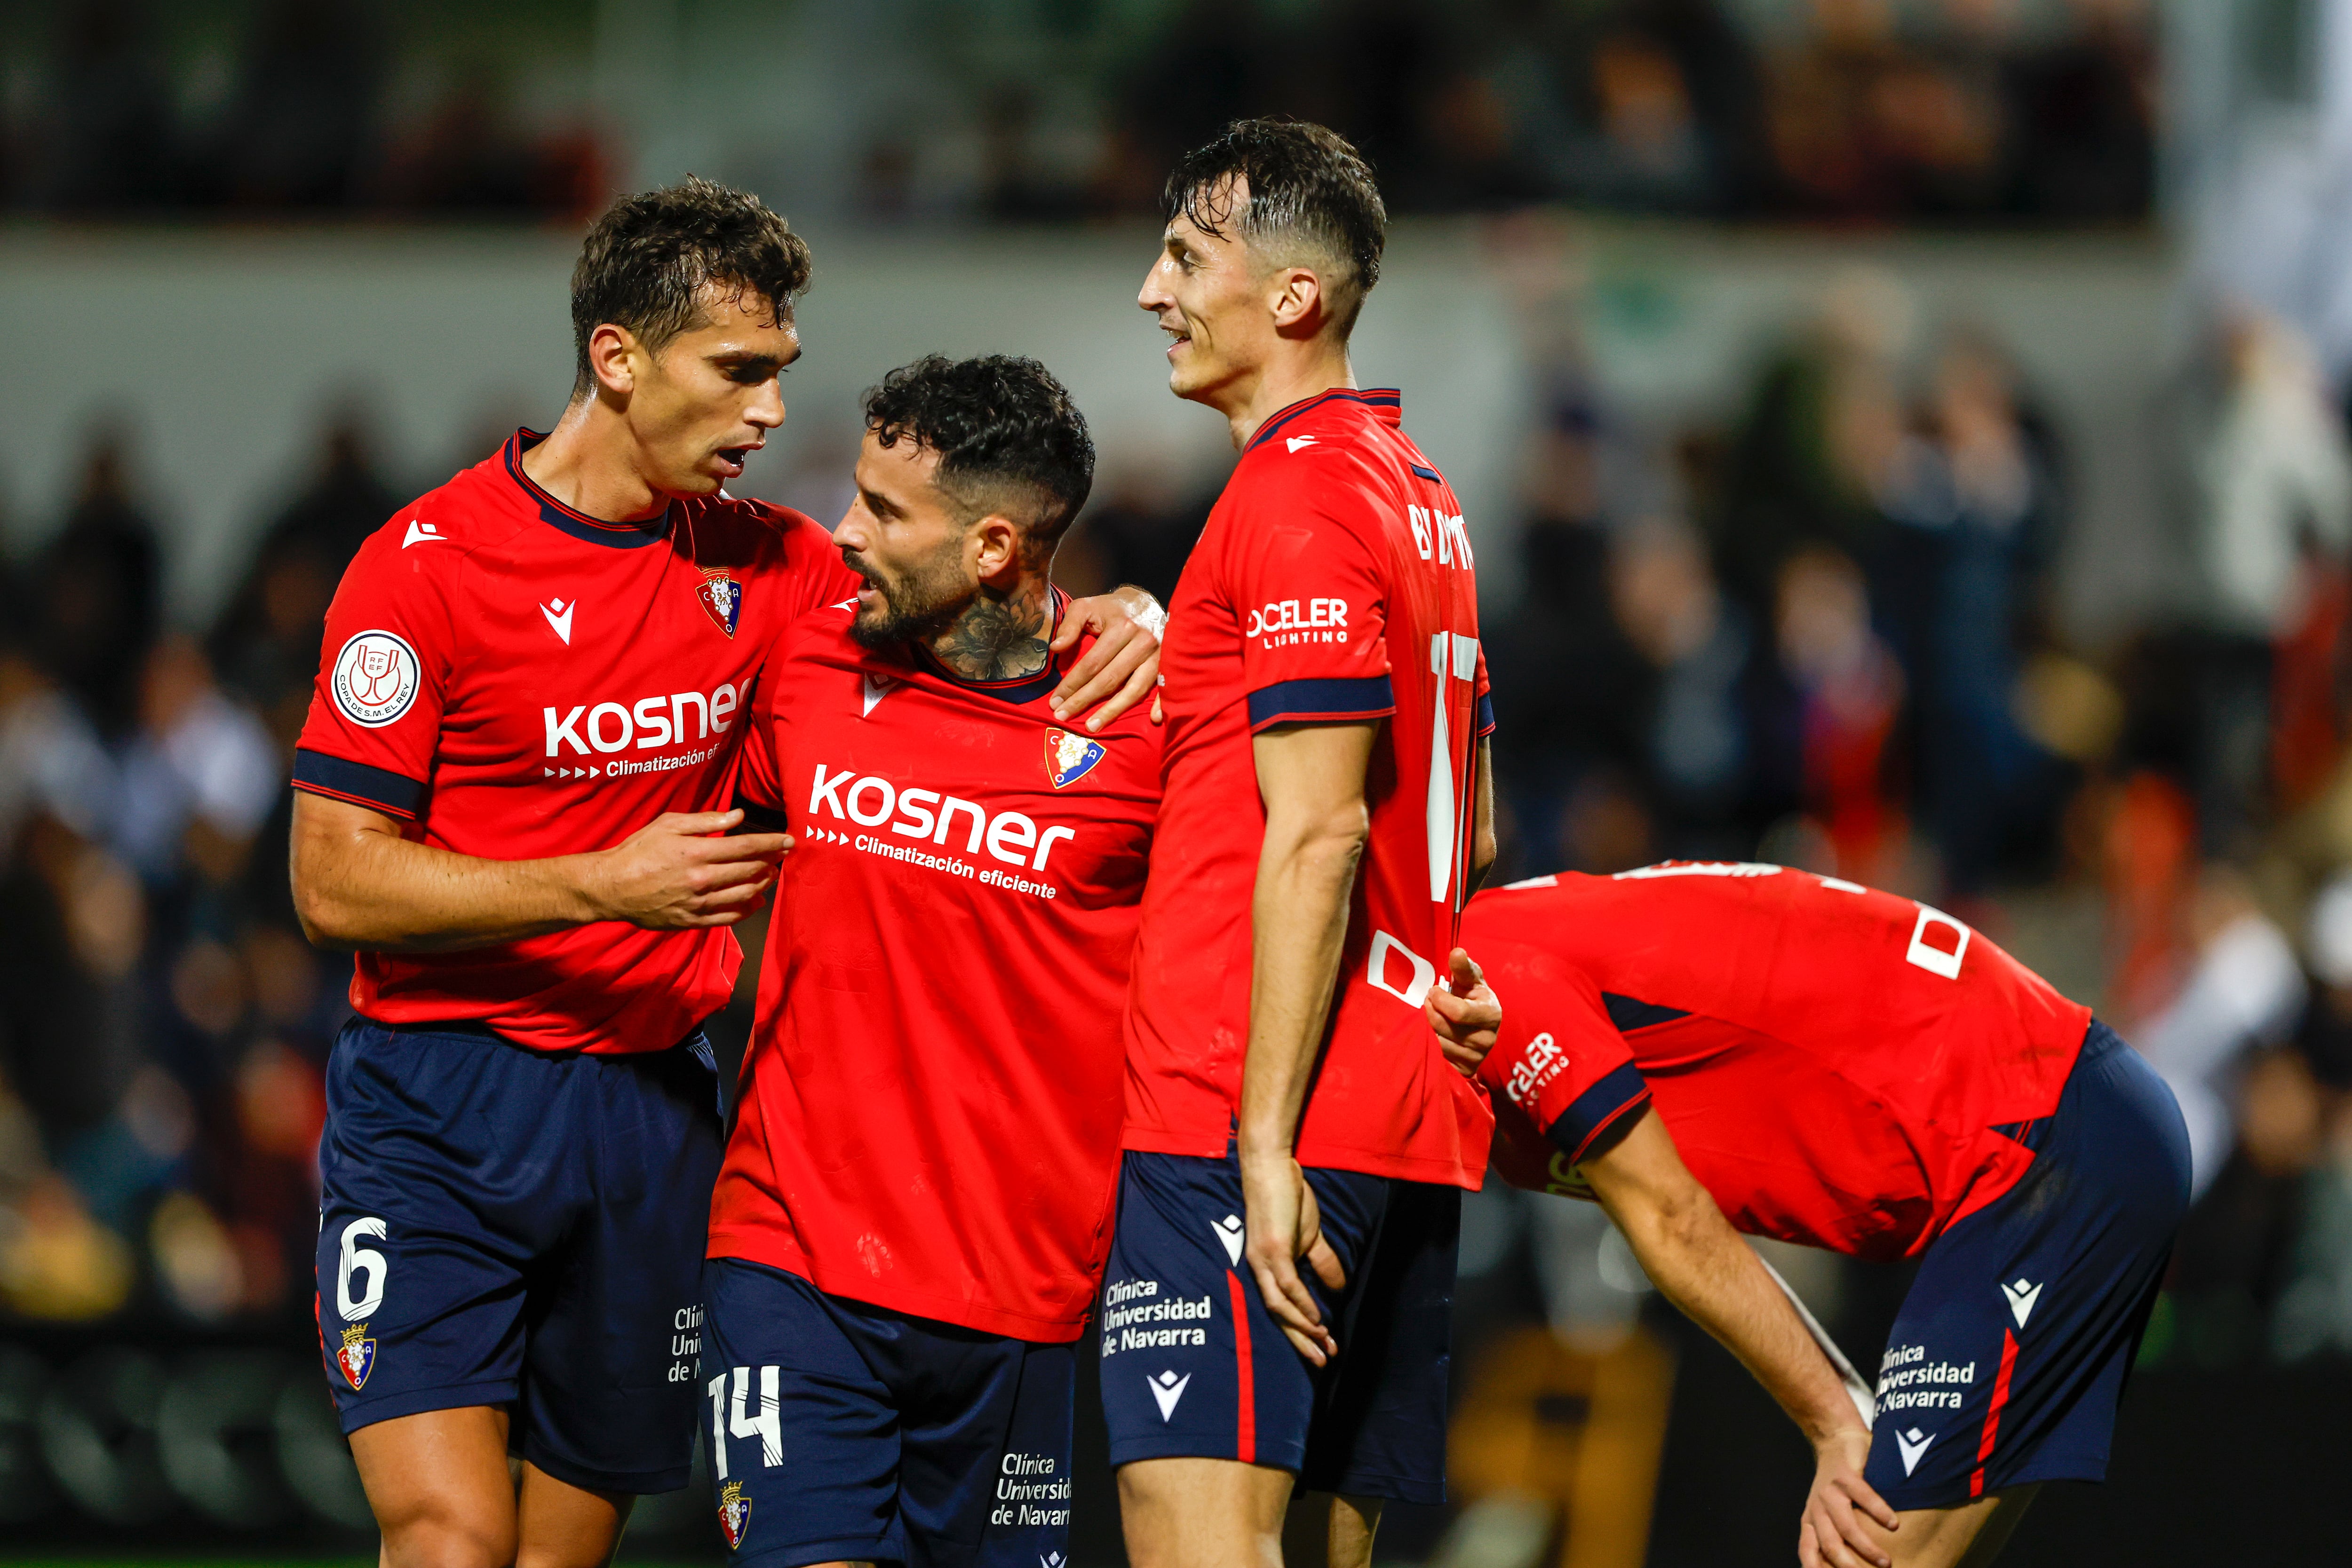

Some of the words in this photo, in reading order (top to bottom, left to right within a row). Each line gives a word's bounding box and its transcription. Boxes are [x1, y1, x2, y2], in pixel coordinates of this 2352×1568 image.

[340, 674, 352, 704] COPA
[351, 702, 363, 714] DE
[385, 704, 398, 714] EL
[396, 683, 410, 704] REY
[606, 749, 705, 777] Climatización
[854, 834, 974, 879] Climatización
[979, 869, 1057, 899] eficiente
[336, 1217, 388, 1322] 6
[1106, 1277, 1158, 1307] Clínica
[1104, 1295, 1211, 1332] Universidad
[1102, 1334, 1117, 1358] de
[1120, 1327, 1206, 1352] Navarra
[668, 1361, 690, 1382] de
[1882, 1391, 1963, 1413] Navarra
[708, 1365, 784, 1481] 14
[1002, 1453, 1055, 1475] Clínica
[991, 1505, 1013, 1525] de
